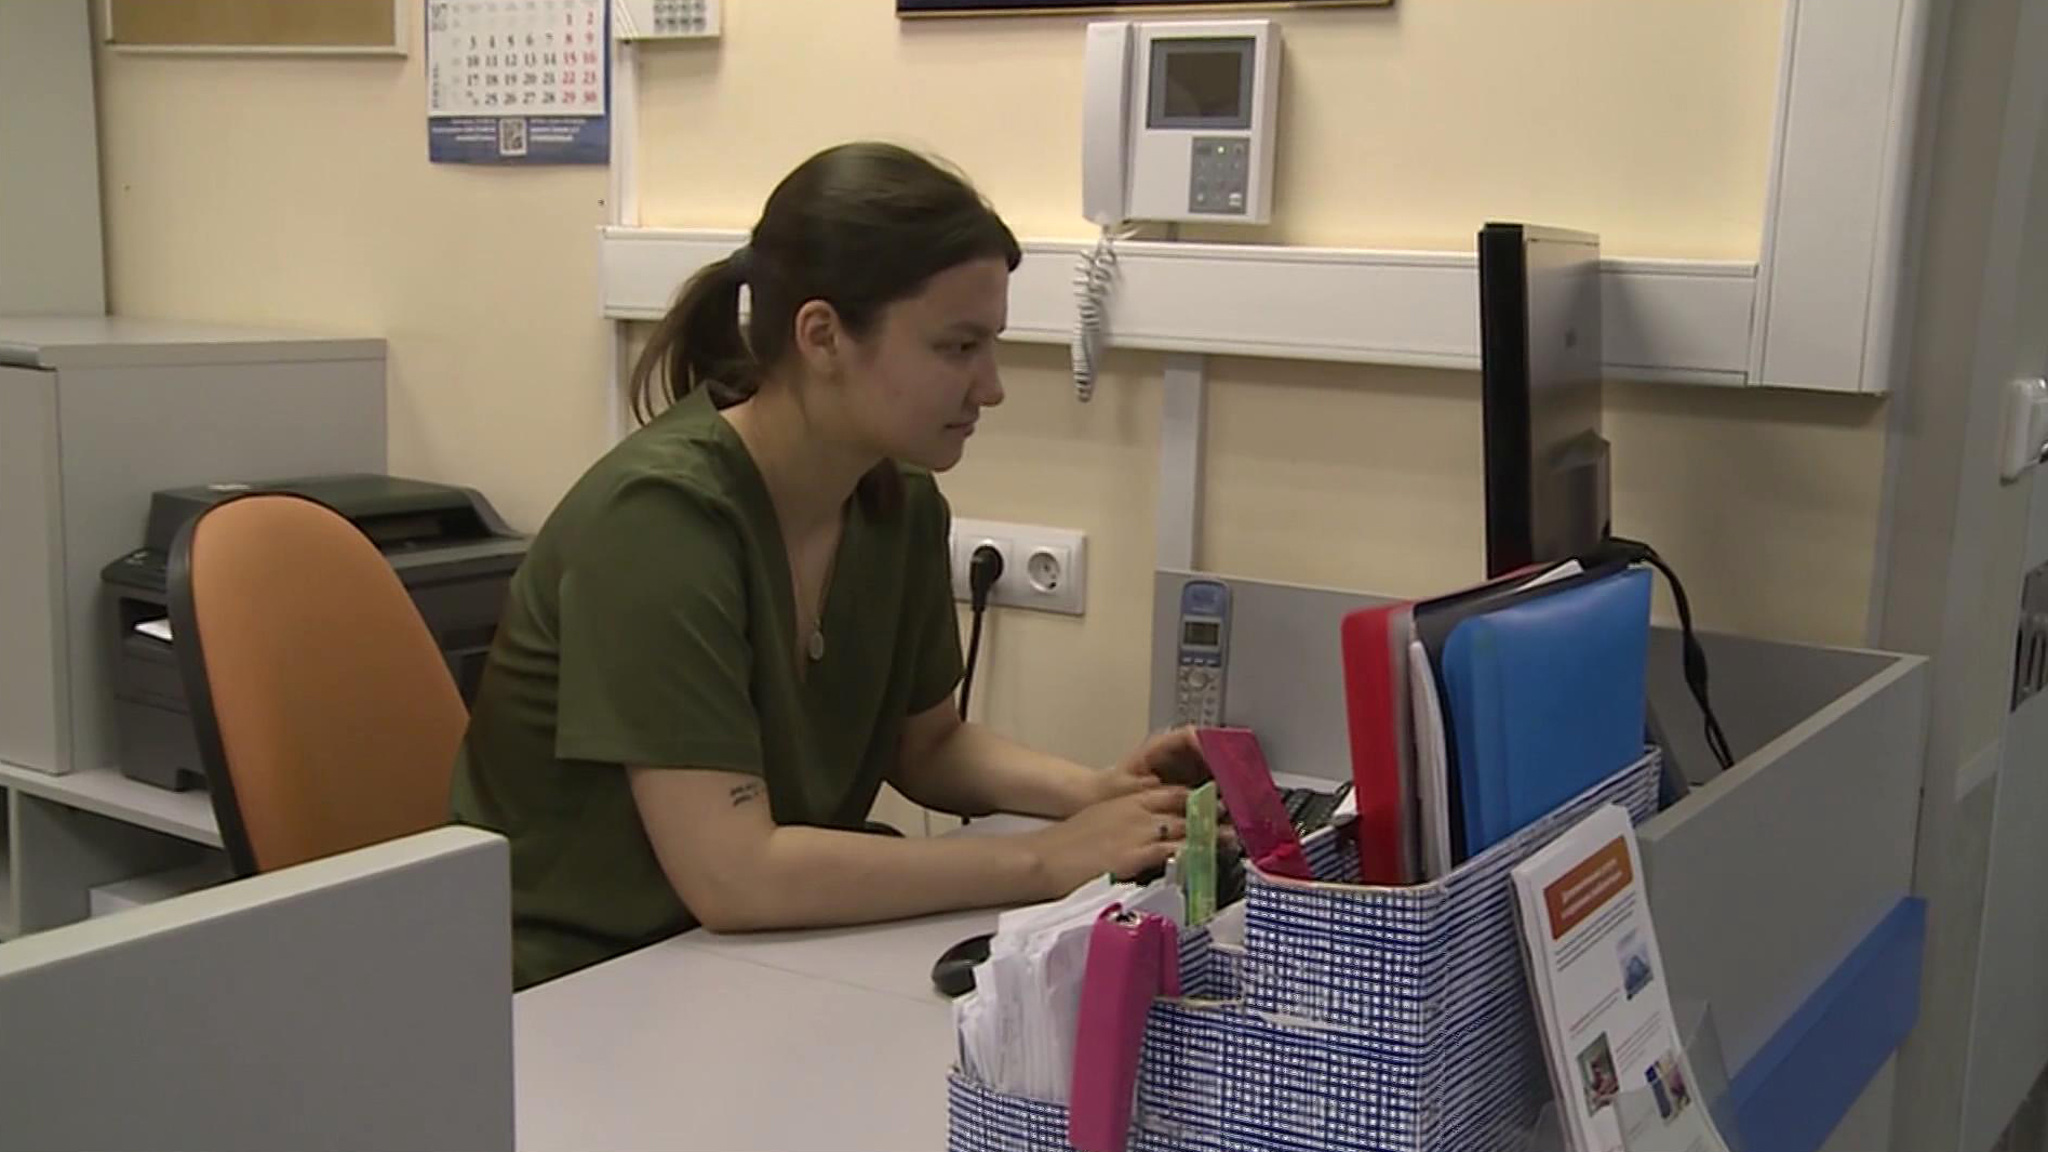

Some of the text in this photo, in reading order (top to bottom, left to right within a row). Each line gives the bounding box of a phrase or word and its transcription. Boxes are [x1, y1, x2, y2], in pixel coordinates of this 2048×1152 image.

[586, 11, 595, 26] 2
[469, 35, 477, 50] 3
[507, 33, 516, 47] 5
[525, 34, 534, 46] 6
[564, 33, 574, 45] 8
[585, 31, 595, 43] 9
[466, 52, 598, 69] 10 11 12 13 14 15 16
[466, 70, 597, 87] 17 18 19 20 21 22 23
[484, 92, 499, 105] 25
[503, 92, 517, 105] 26
[522, 92, 537, 105] 27
[542, 91, 556, 105] 28
[562, 91, 576, 104] 29
[583, 91, 598, 104] 30
